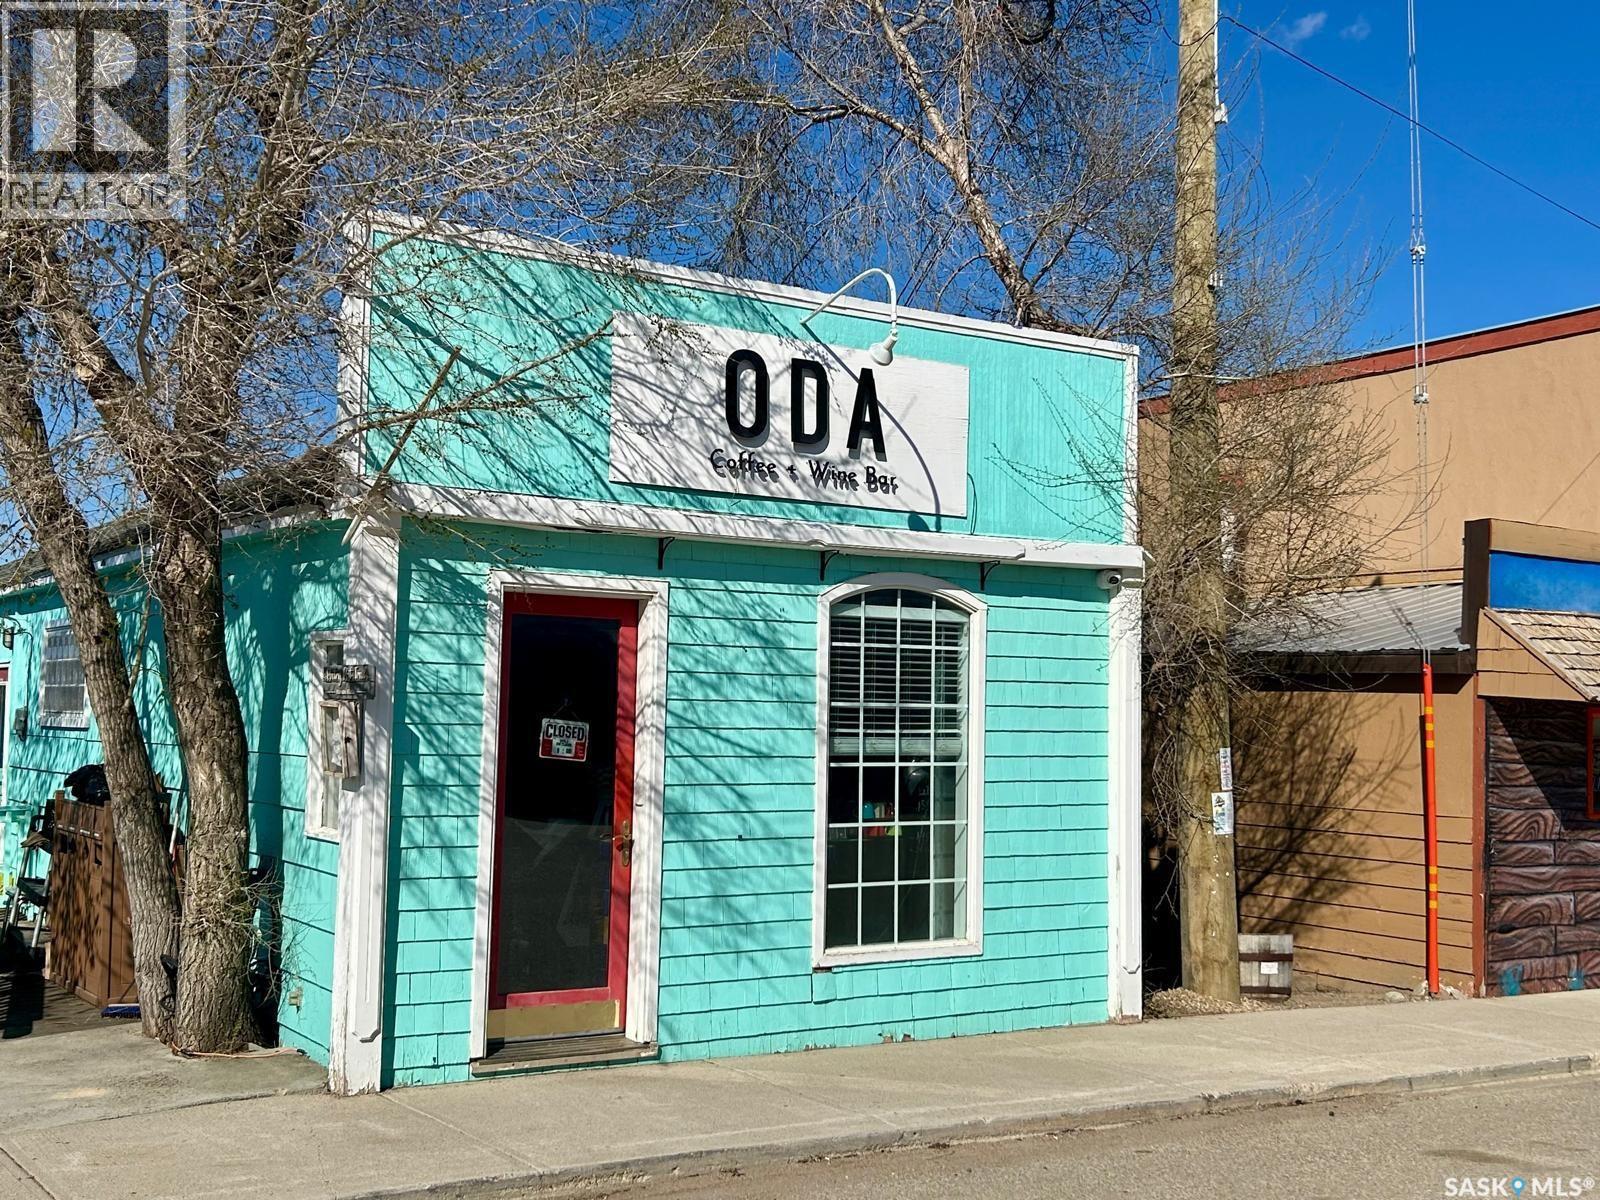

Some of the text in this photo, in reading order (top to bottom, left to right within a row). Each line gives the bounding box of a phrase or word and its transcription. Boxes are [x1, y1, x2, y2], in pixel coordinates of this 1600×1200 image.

[725, 349, 887, 462] ODA
[710, 448, 777, 477] Coffee
[808, 459, 857, 483] Wine
[866, 465, 898, 487] Bar
[545, 723, 585, 741] CLOSED
